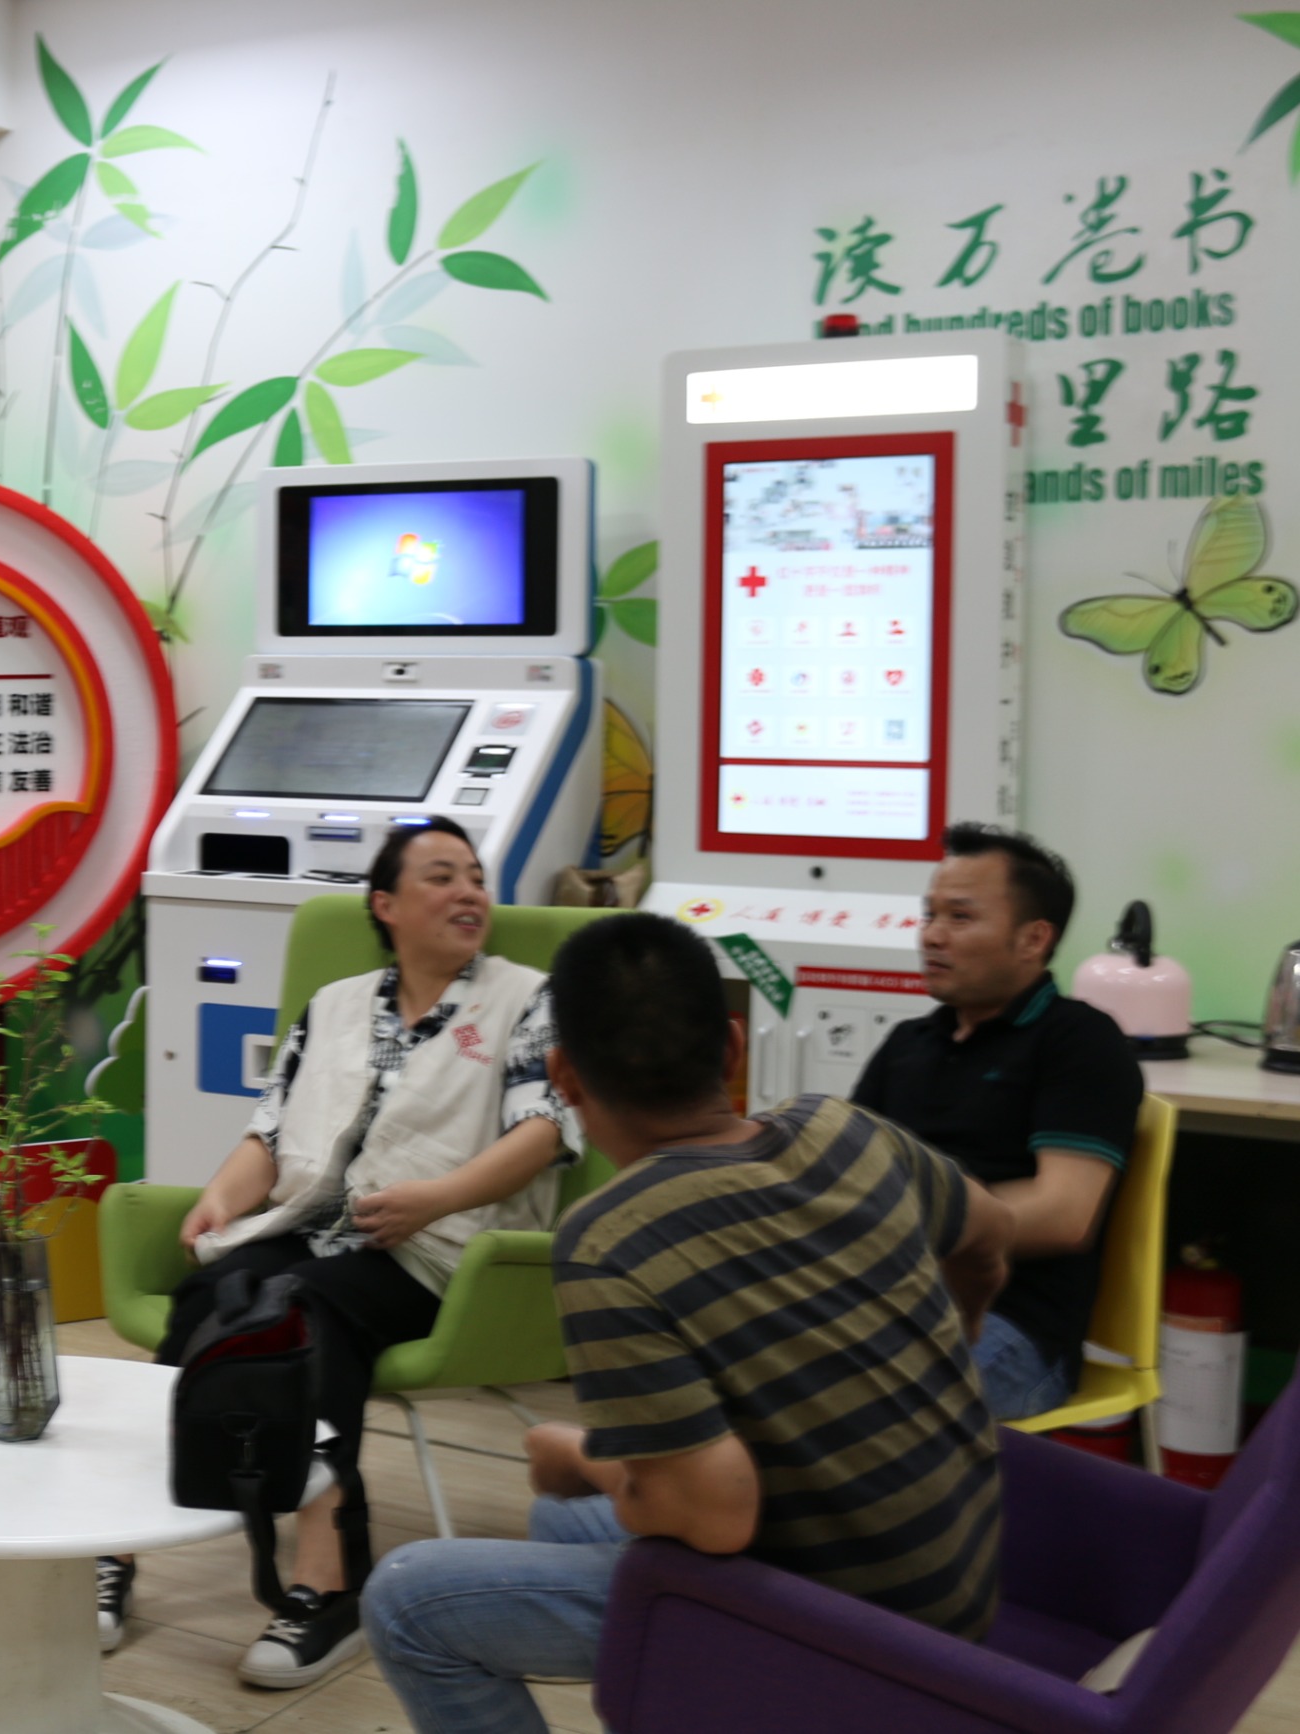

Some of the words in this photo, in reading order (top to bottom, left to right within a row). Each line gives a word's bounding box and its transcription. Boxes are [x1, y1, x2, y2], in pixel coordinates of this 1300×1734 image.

[1081, 296, 1112, 338] of
[1124, 288, 1235, 334] books
[1115, 459, 1150, 500] of
[1159, 456, 1265, 498] miles
[9, 694, 54, 719] 和谐
[9, 732, 54, 757] 法治
[9, 770, 54, 795] 友善
